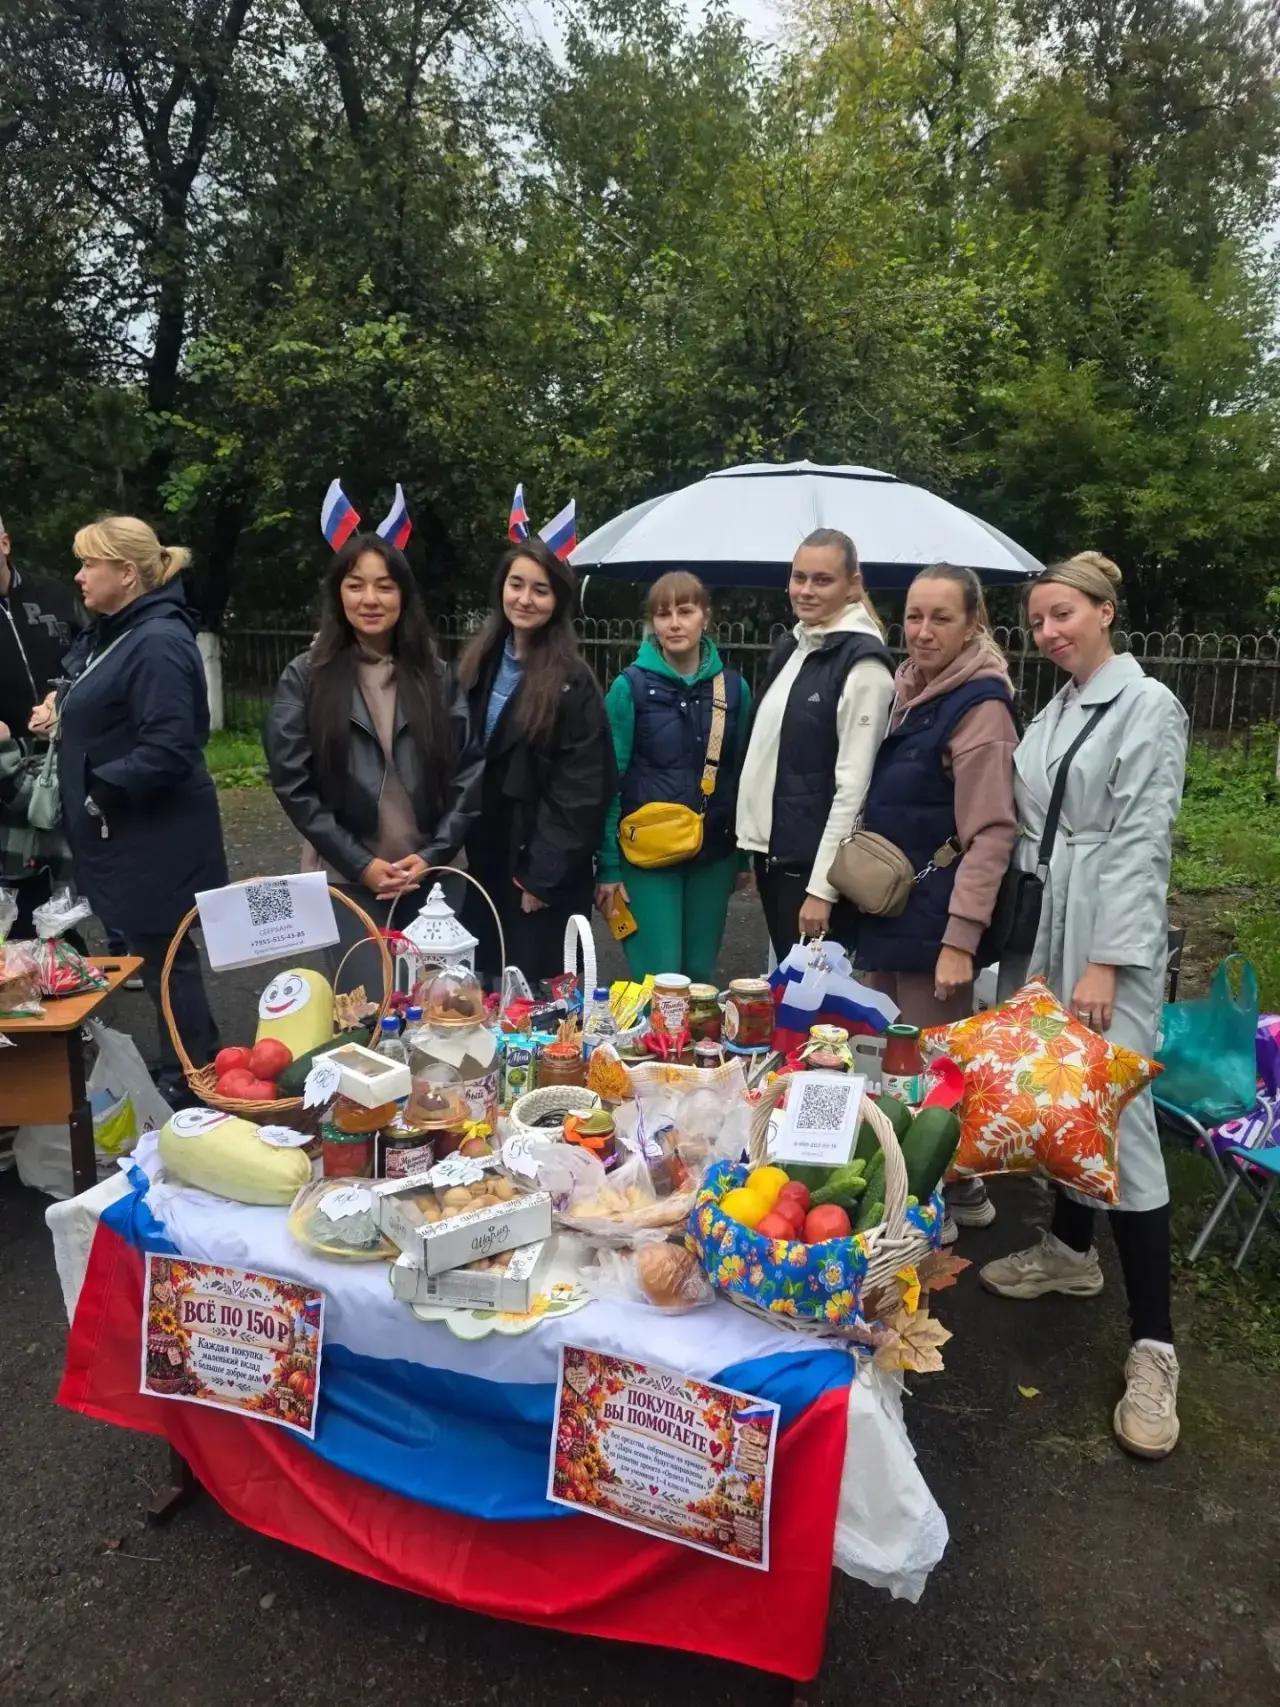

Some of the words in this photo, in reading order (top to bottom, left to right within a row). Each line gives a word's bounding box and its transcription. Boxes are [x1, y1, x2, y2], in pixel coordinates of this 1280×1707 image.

[184, 1300, 216, 1323] ВСЁ
[221, 1305, 242, 1327] ПО
[247, 1309, 274, 1339] 150
[198, 1337, 229, 1353] Каждая
[232, 1347, 263, 1360] покупка
[202, 1353, 239, 1366] маленький
[240, 1360, 261, 1372] вклад
[627, 1390, 695, 1427] ПОКУПАЯ
[604, 1403, 624, 1421] ВЫ
[627, 1407, 708, 1454] ПОМОГАЕТЕ
